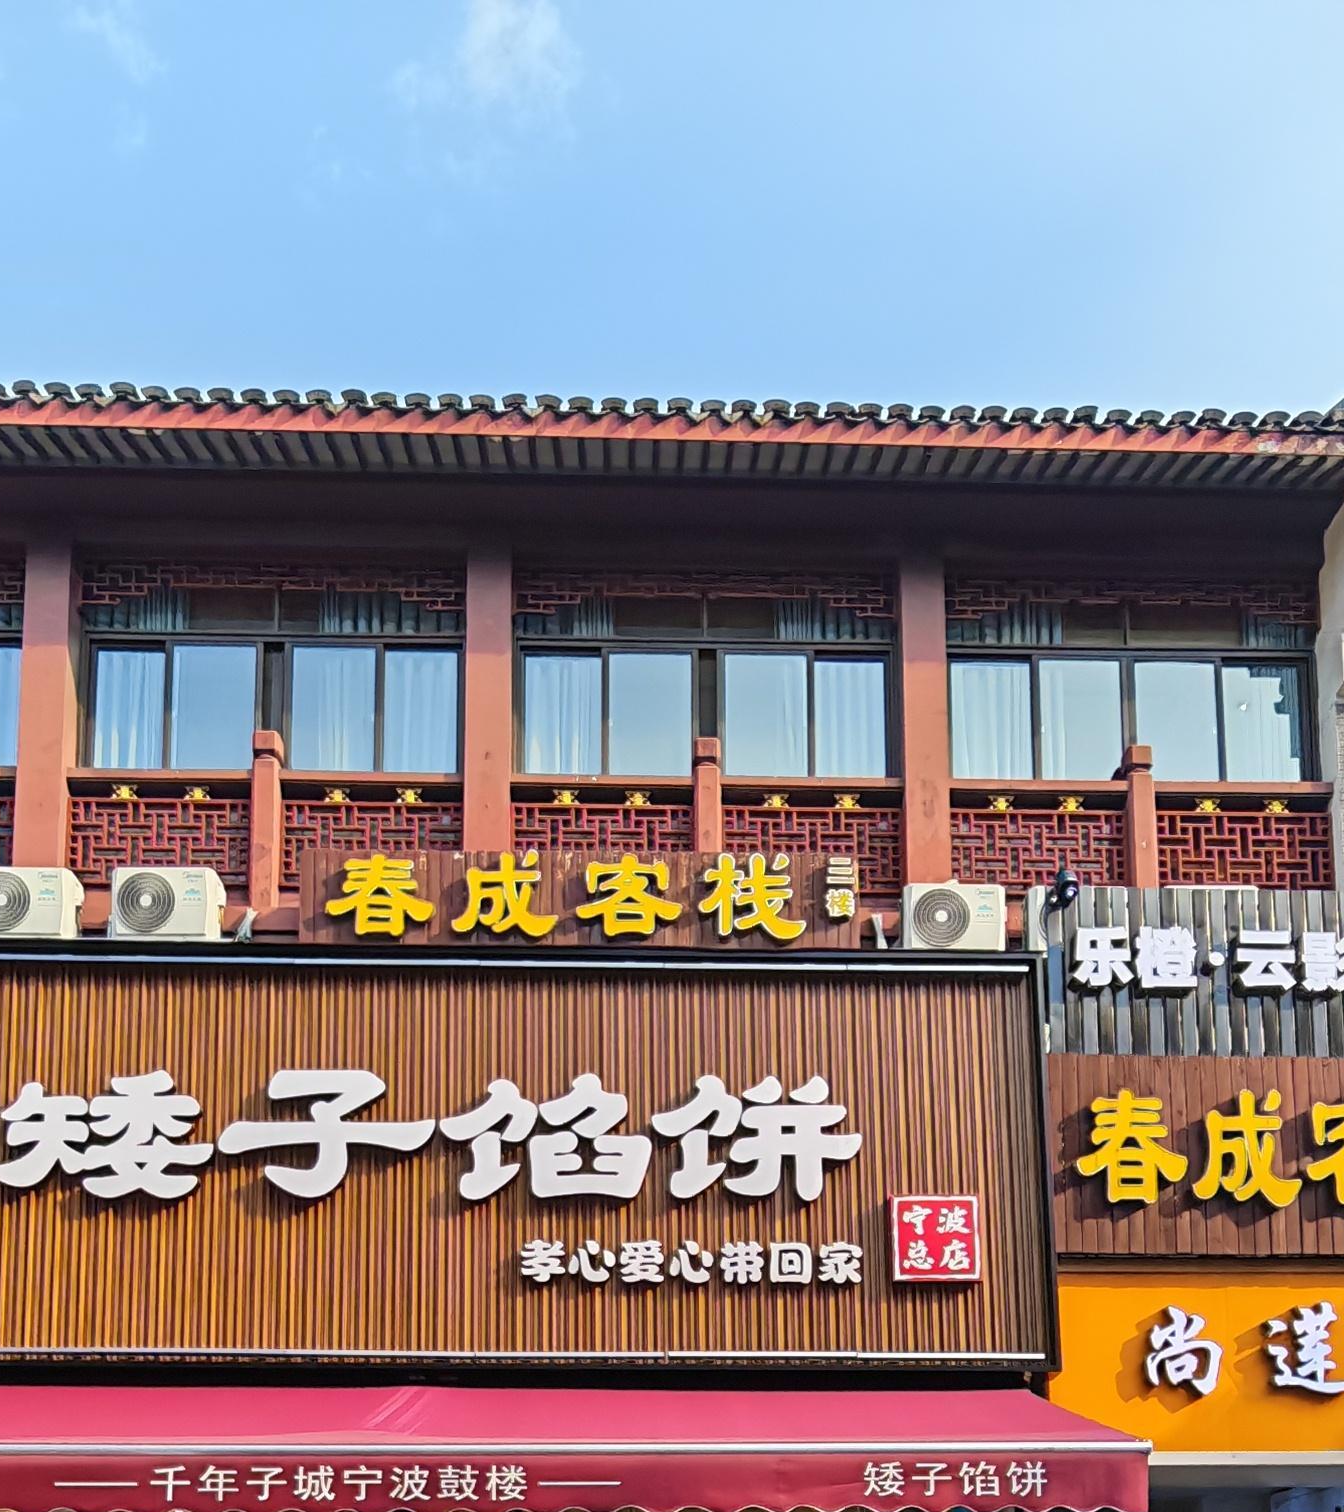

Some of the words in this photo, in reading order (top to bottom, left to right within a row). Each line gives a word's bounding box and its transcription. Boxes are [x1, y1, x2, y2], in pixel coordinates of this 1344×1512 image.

[325, 850, 806, 940] 春成客栈
[824, 857, 854, 918] 三楼
[902, 1204, 972, 1237] 宁波
[520, 1238, 864, 1285] 孝心爱心带回家
[902, 1238, 973, 1272] 总店
[149, 1464, 528, 1502] 千年子城宁波鼓楼
[863, 1460, 1048, 1499] 矮子馅饼
